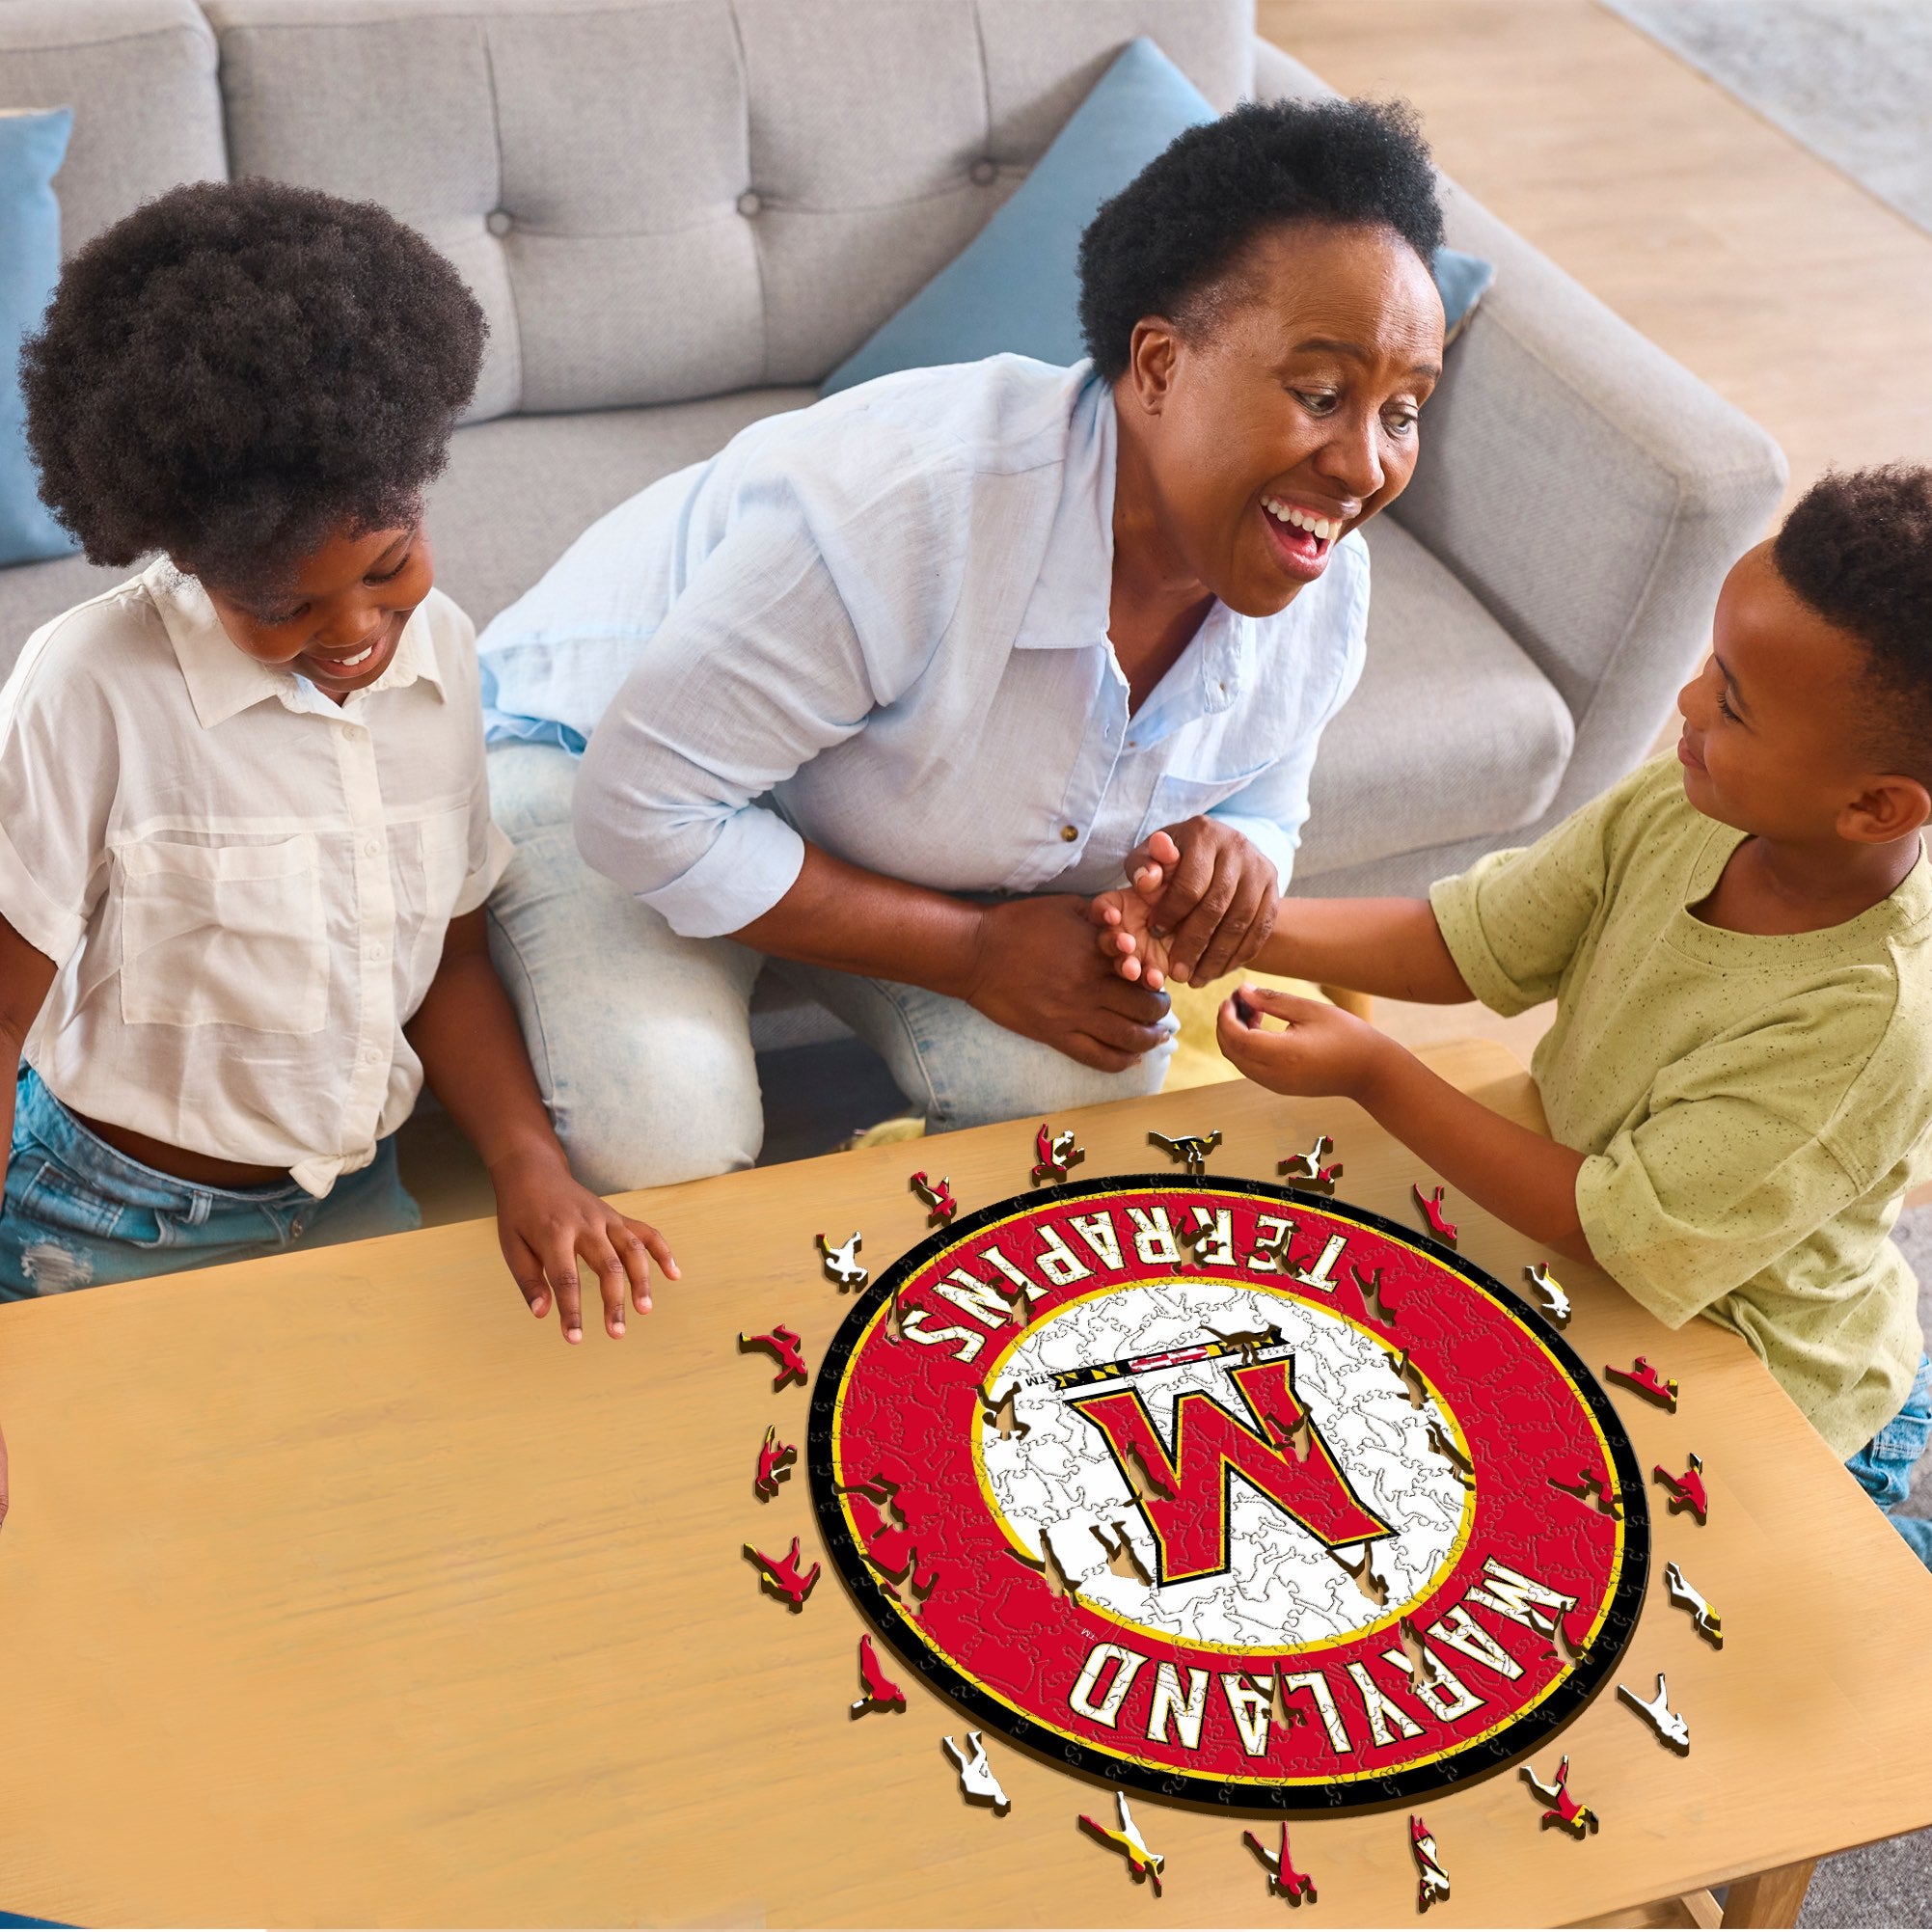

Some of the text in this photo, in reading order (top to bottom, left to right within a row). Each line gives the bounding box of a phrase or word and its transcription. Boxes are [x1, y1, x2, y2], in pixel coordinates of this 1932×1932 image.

[904, 1206, 1347, 1363] TERRAPINS
[1064, 1356, 1400, 1588] M
[1068, 1556, 1578, 1756] MARYLAND
